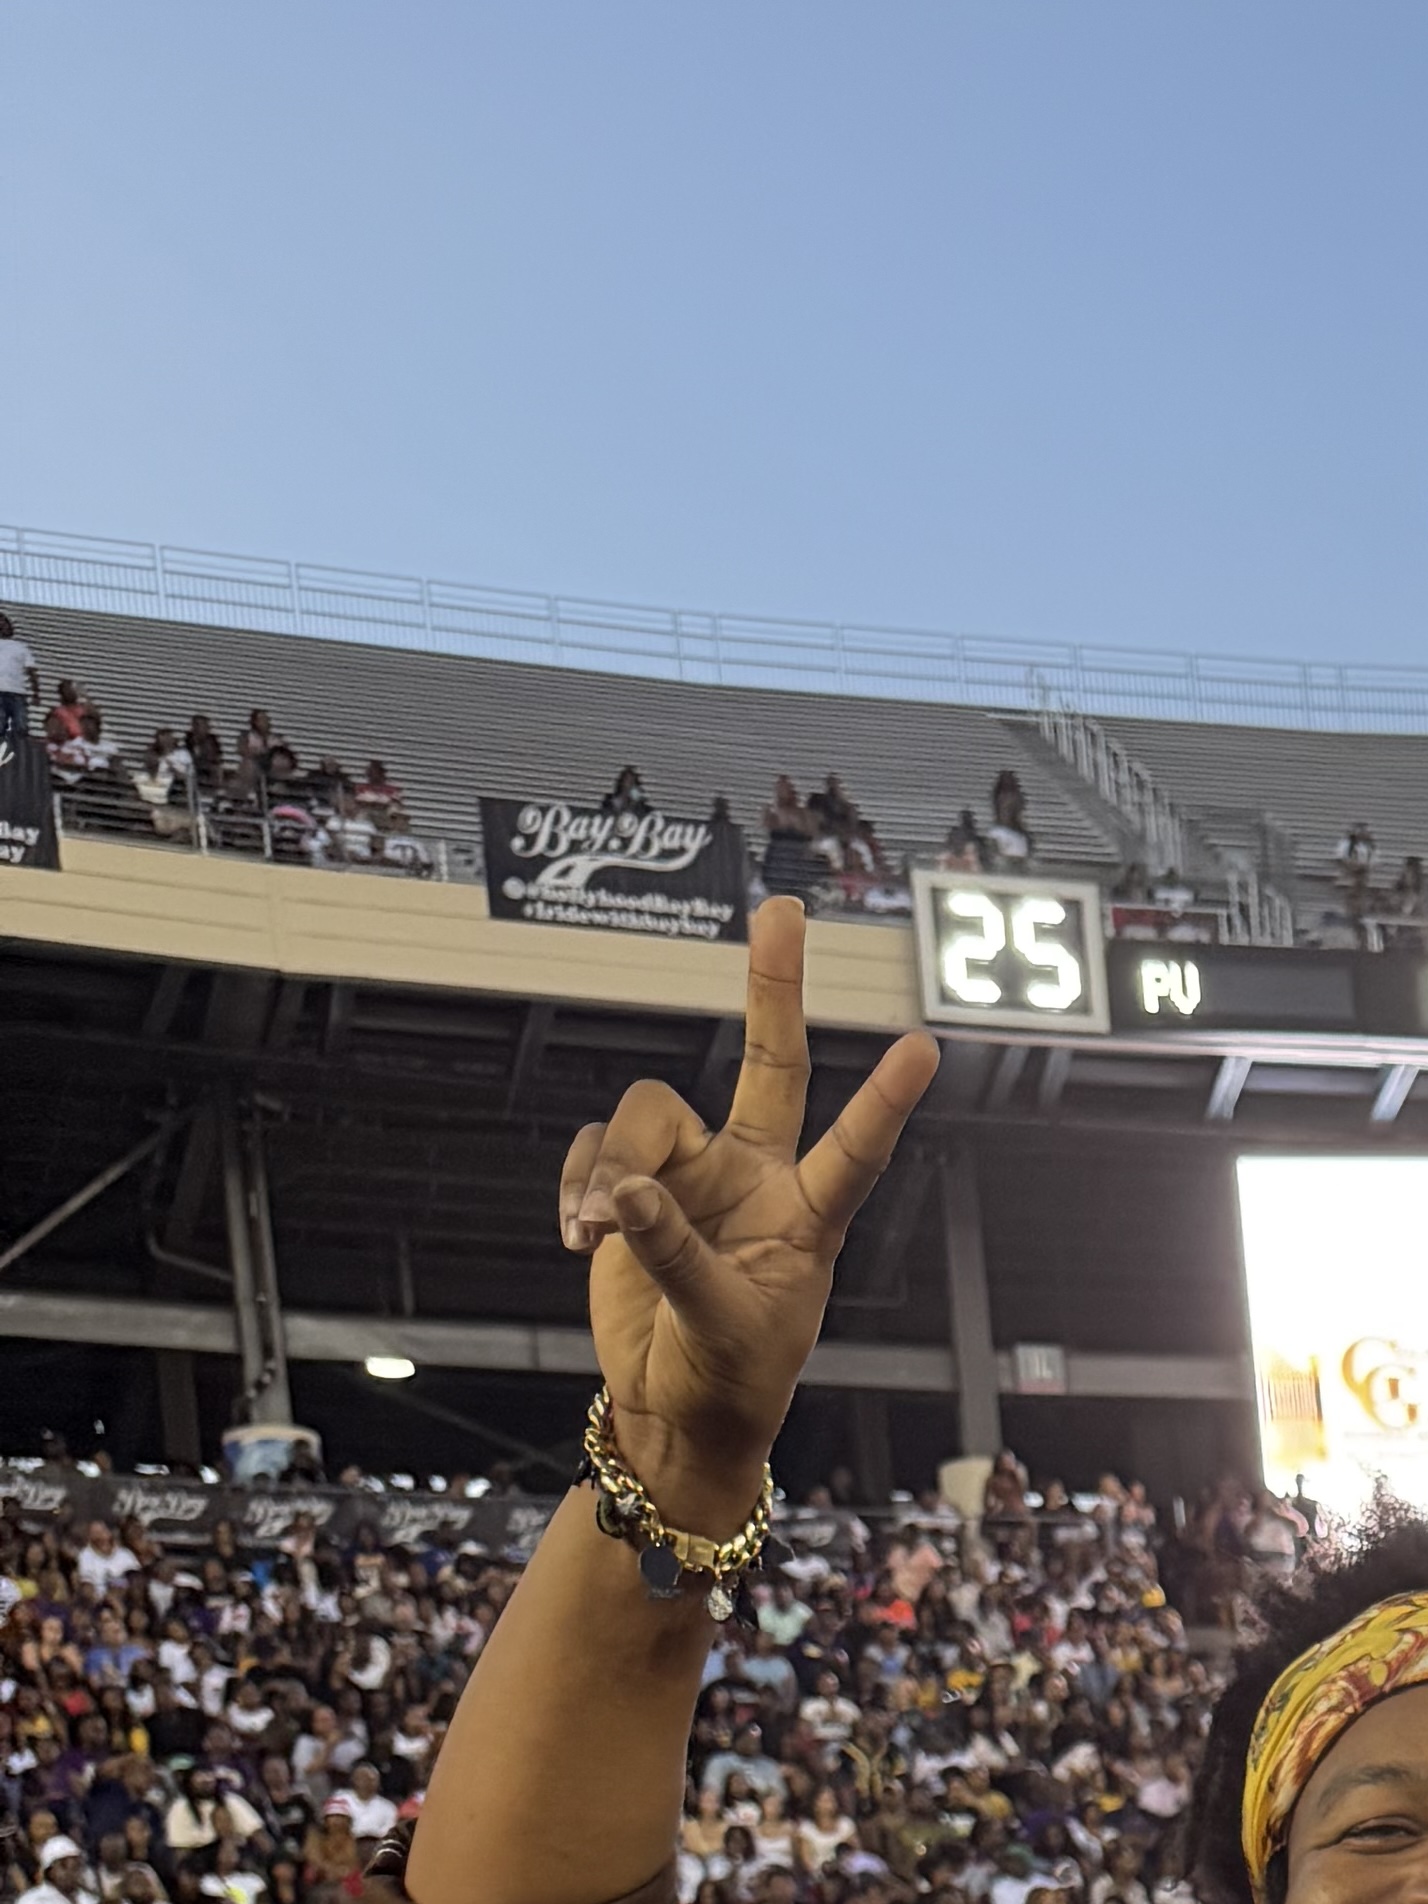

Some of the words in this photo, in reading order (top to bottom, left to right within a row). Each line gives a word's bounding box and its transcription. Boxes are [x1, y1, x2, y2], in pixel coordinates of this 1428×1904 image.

[511, 804, 614, 857] Bay
[608, 810, 713, 859] Bay
[945, 892, 1082, 1009] 25
[1141, 960, 1201, 1014] PV
